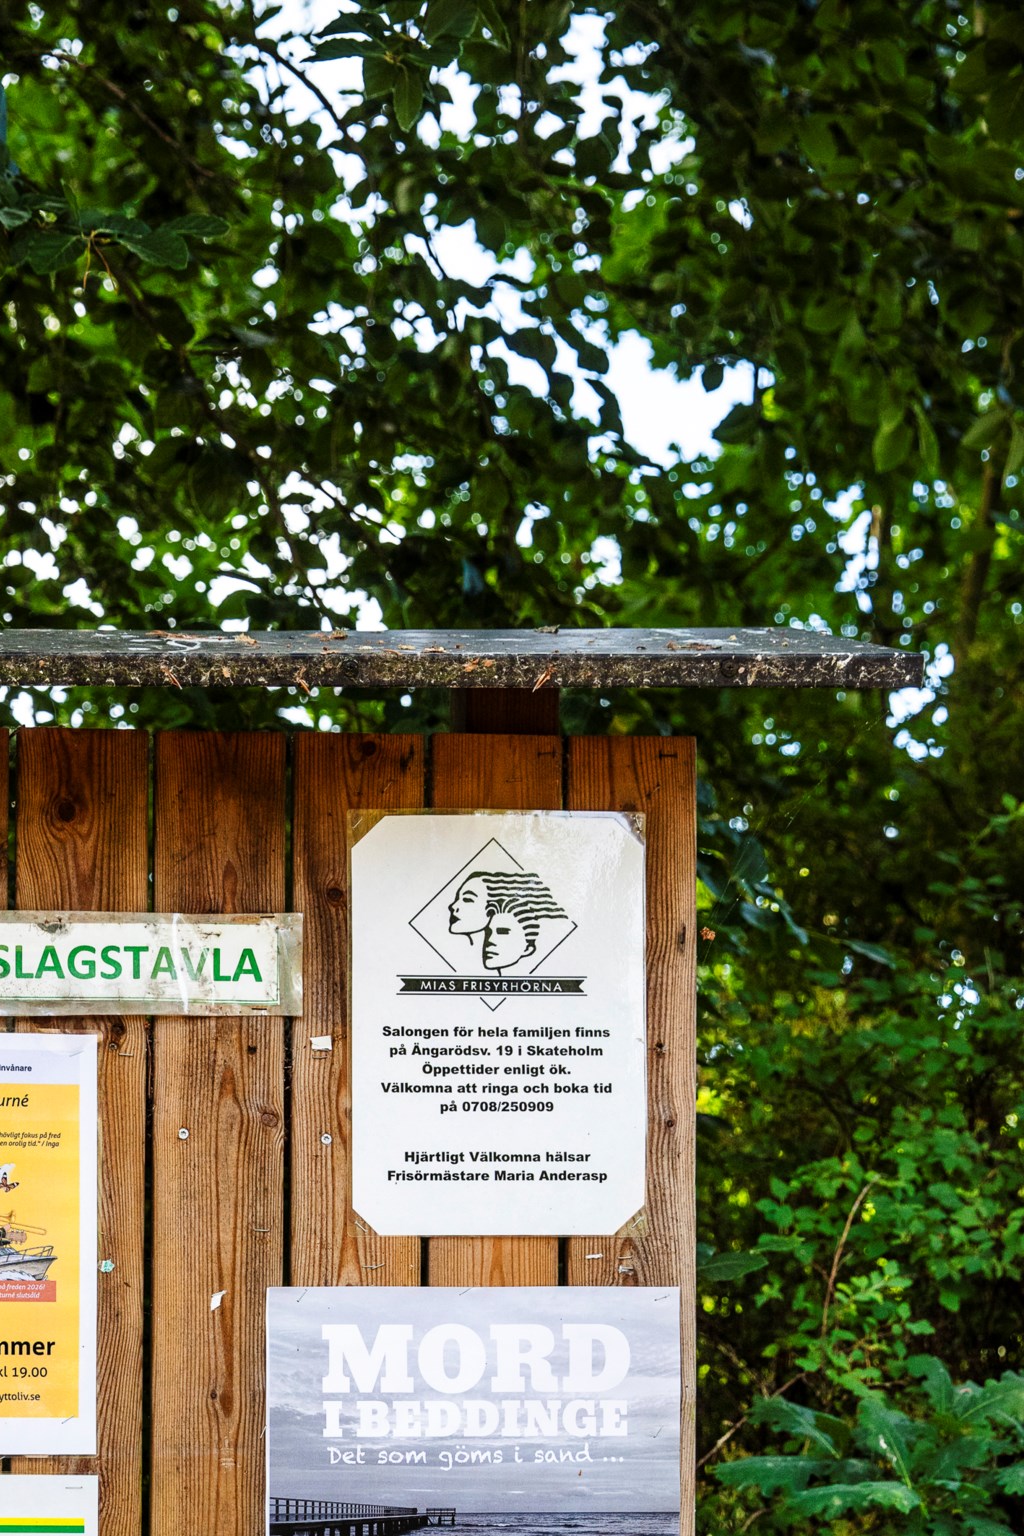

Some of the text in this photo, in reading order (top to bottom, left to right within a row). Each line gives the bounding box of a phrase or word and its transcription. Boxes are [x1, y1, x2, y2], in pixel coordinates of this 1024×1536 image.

[420, 979, 563, 993] MIAS FRISYRHÖRNA
[383, 1026, 610, 1039] Salongen för hela familjen finns
[390, 1044, 406, 1057] på
[412, 1043, 490, 1058] Ängarödsv.
[496, 1046, 513, 1056] 19
[527, 1046, 603, 1056] Skateholm
[422, 1062, 570, 1077] Öppettider enligt ök.
[441, 1101, 553, 1114] på 0708/250909
[388, 1171, 607, 1184] Frisörmästare Maria Anderasp
[6, 1283, 26, 1292] freden
[322, 1323, 631, 1394] MORD
[12, 1367, 47, 1378] 19.00
[323, 1399, 628, 1437] I BEDDINGE
[327, 1445, 365, 1465] Det
[378, 1450, 426, 1465] som
[439, 1445, 503, 1470] göms
[515, 1446, 523, 1462] i
[535, 1443, 593, 1462] sand
